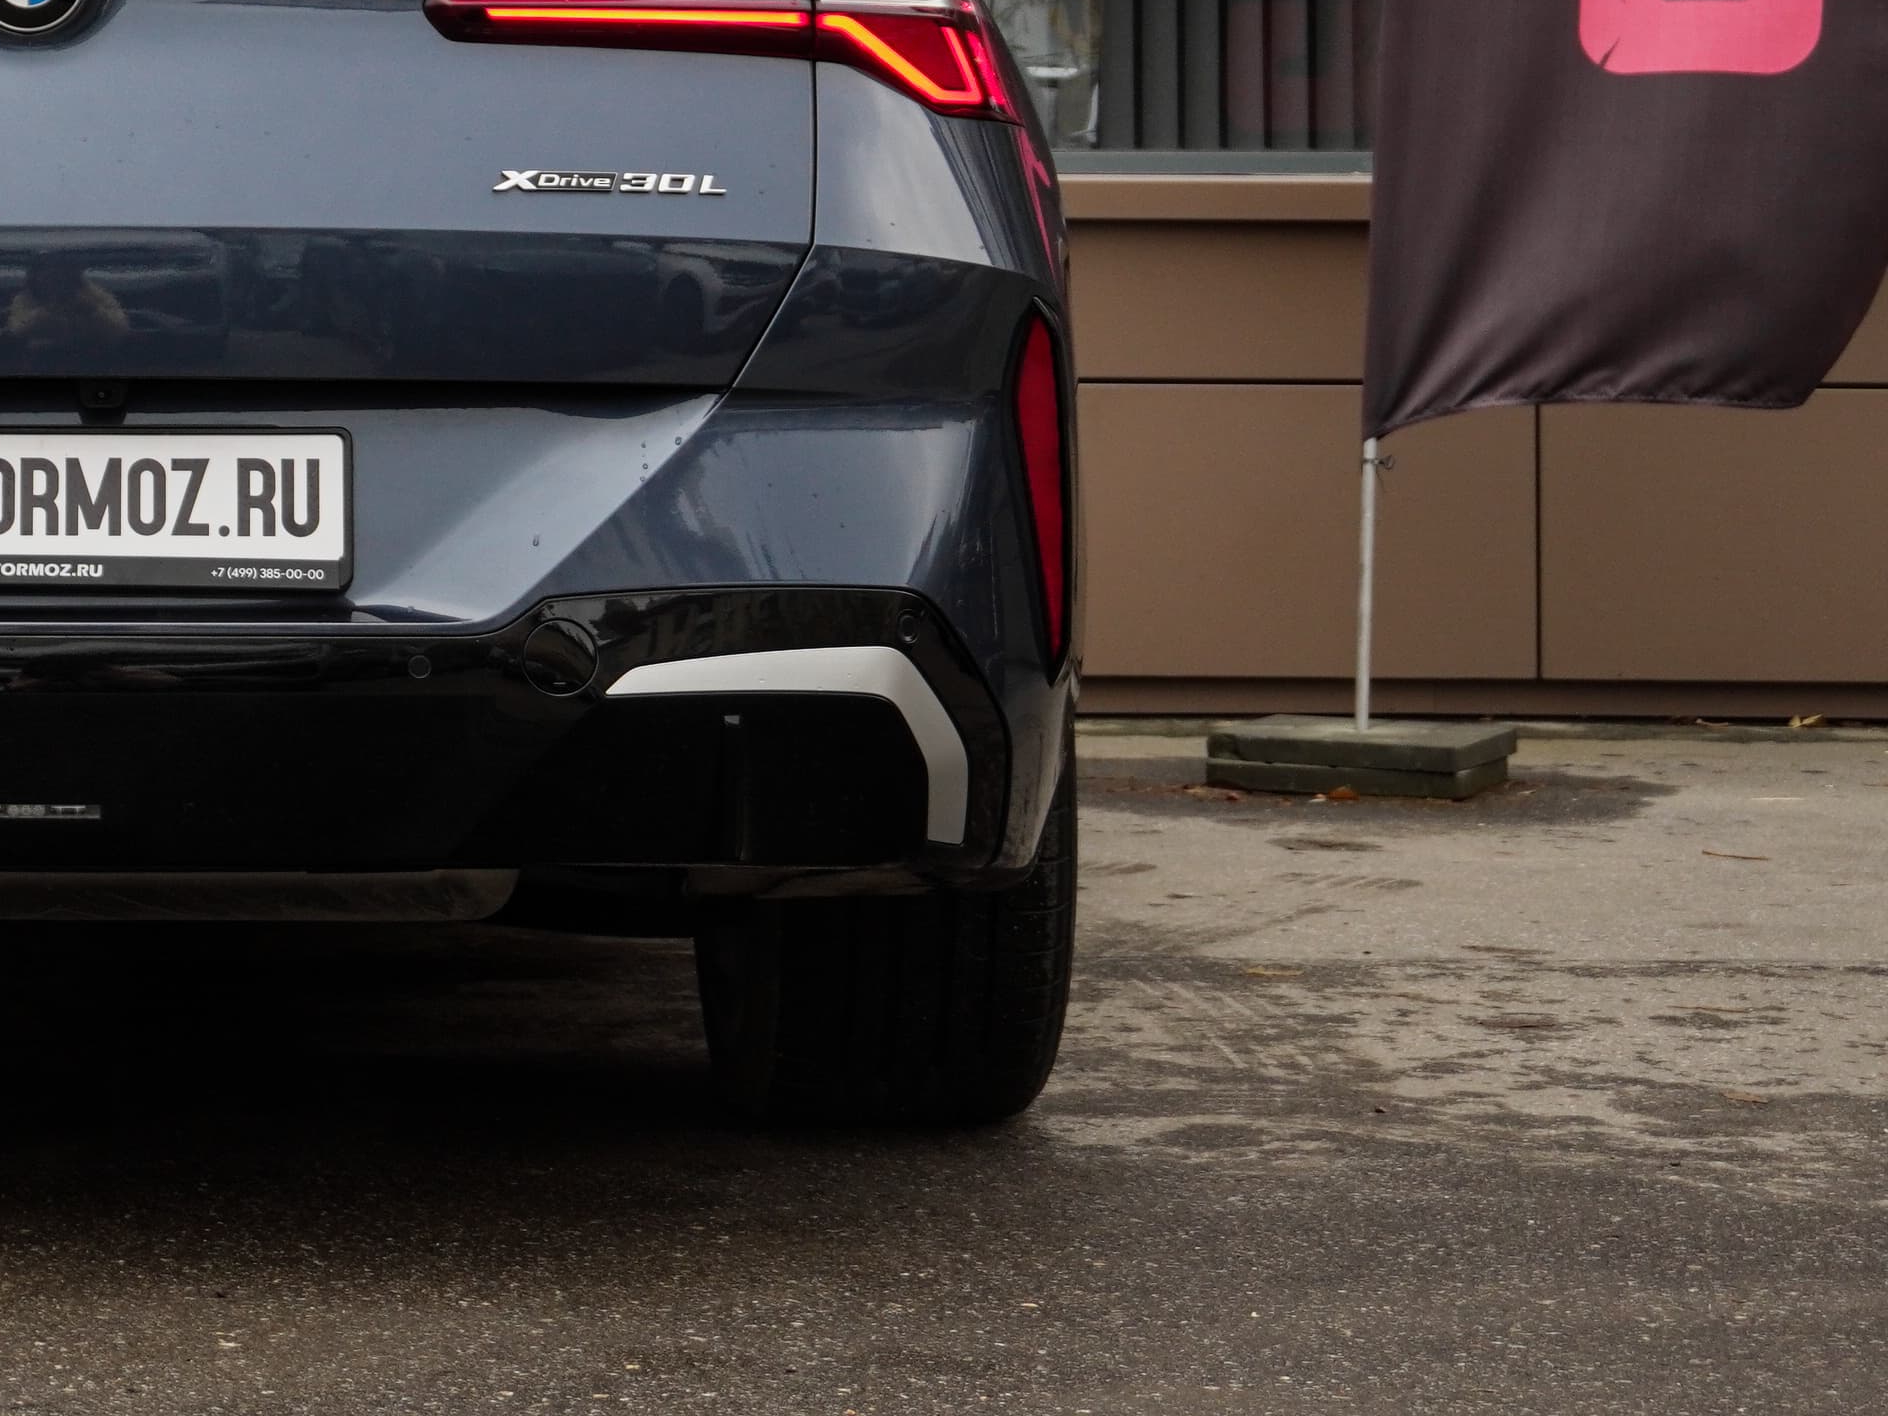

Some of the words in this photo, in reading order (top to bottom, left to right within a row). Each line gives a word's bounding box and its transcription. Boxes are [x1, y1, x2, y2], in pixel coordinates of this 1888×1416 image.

[210, 568, 224, 578] +7
[227, 567, 257, 580] (499)
[259, 568, 325, 580] 385-00-00
